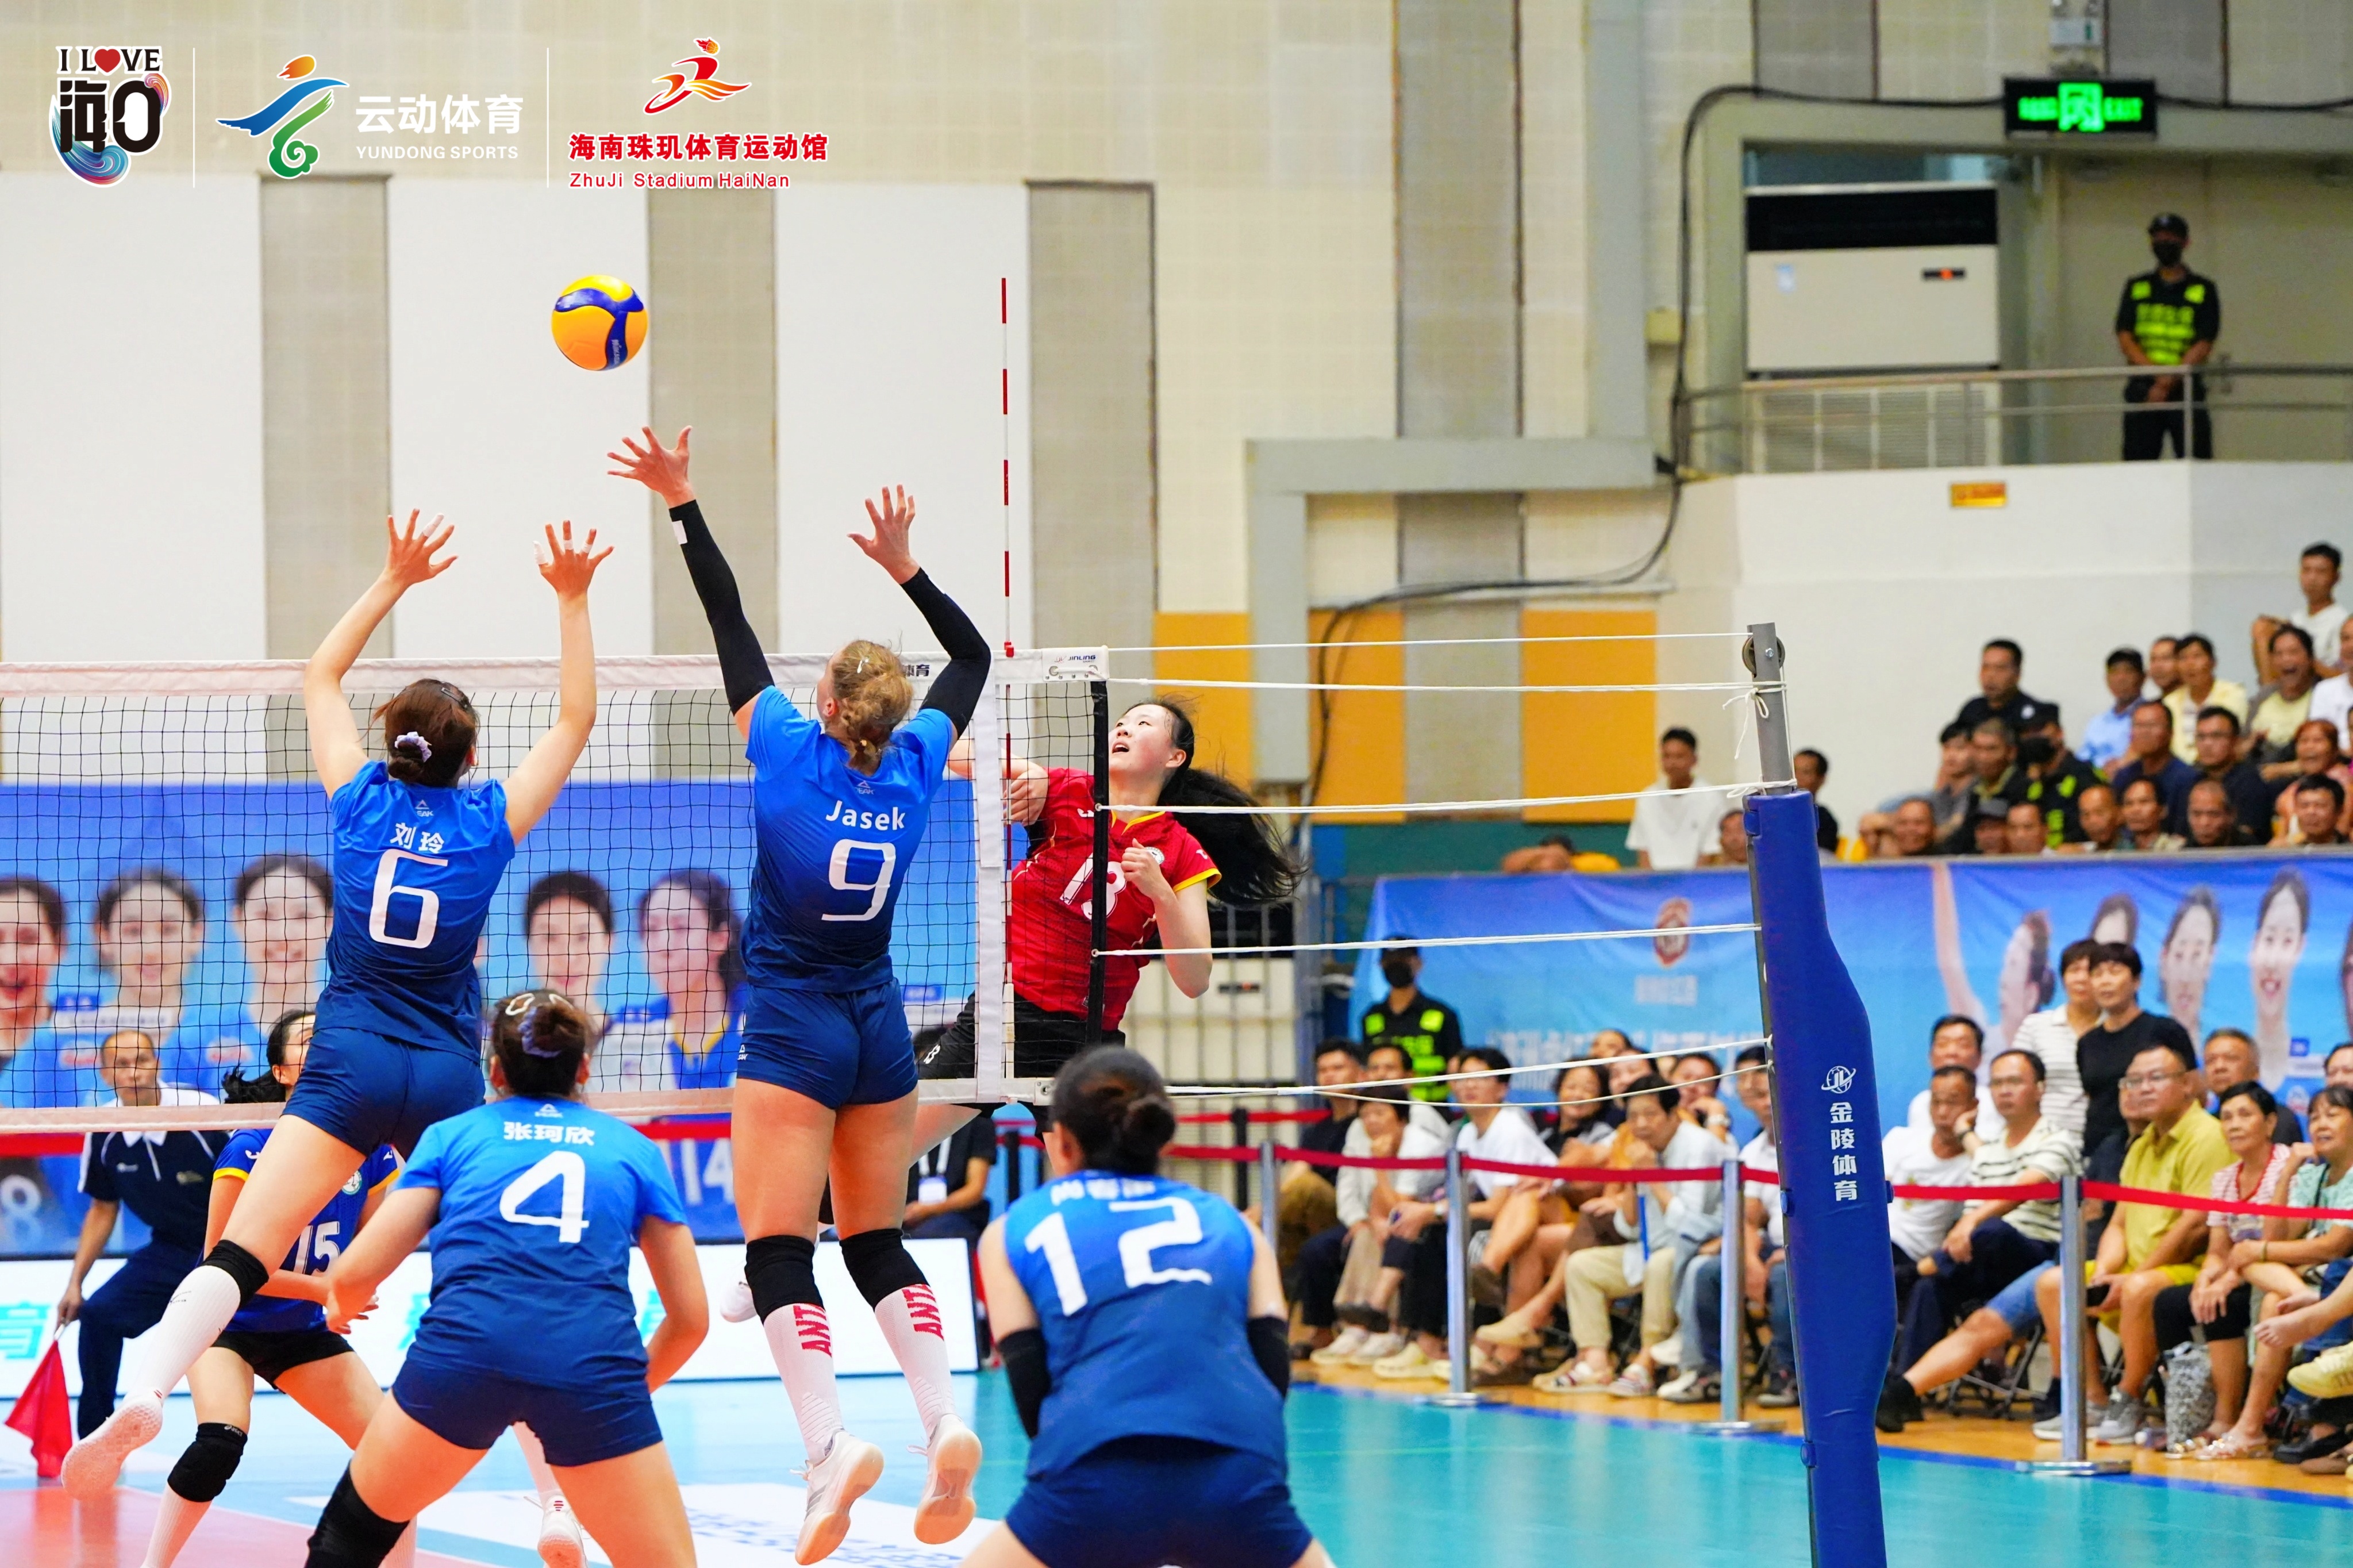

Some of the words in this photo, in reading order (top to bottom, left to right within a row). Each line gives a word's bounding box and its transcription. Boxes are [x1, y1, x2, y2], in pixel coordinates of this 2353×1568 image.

[390, 823, 445, 854] 刘玲
[825, 800, 906, 831] Jasek
[369, 848, 448, 949] 6
[821, 839, 896, 921] 9
[503, 1121, 595, 1146] 张珂欣
[1829, 1101, 1858, 1202] 金陵体育
[499, 1150, 590, 1243] 4
[680, 1138, 735, 1206] 14
[293, 1221, 340, 1277] 15
[1025, 1197, 1212, 1317] 12
[793, 1302, 832, 1358] ANT
